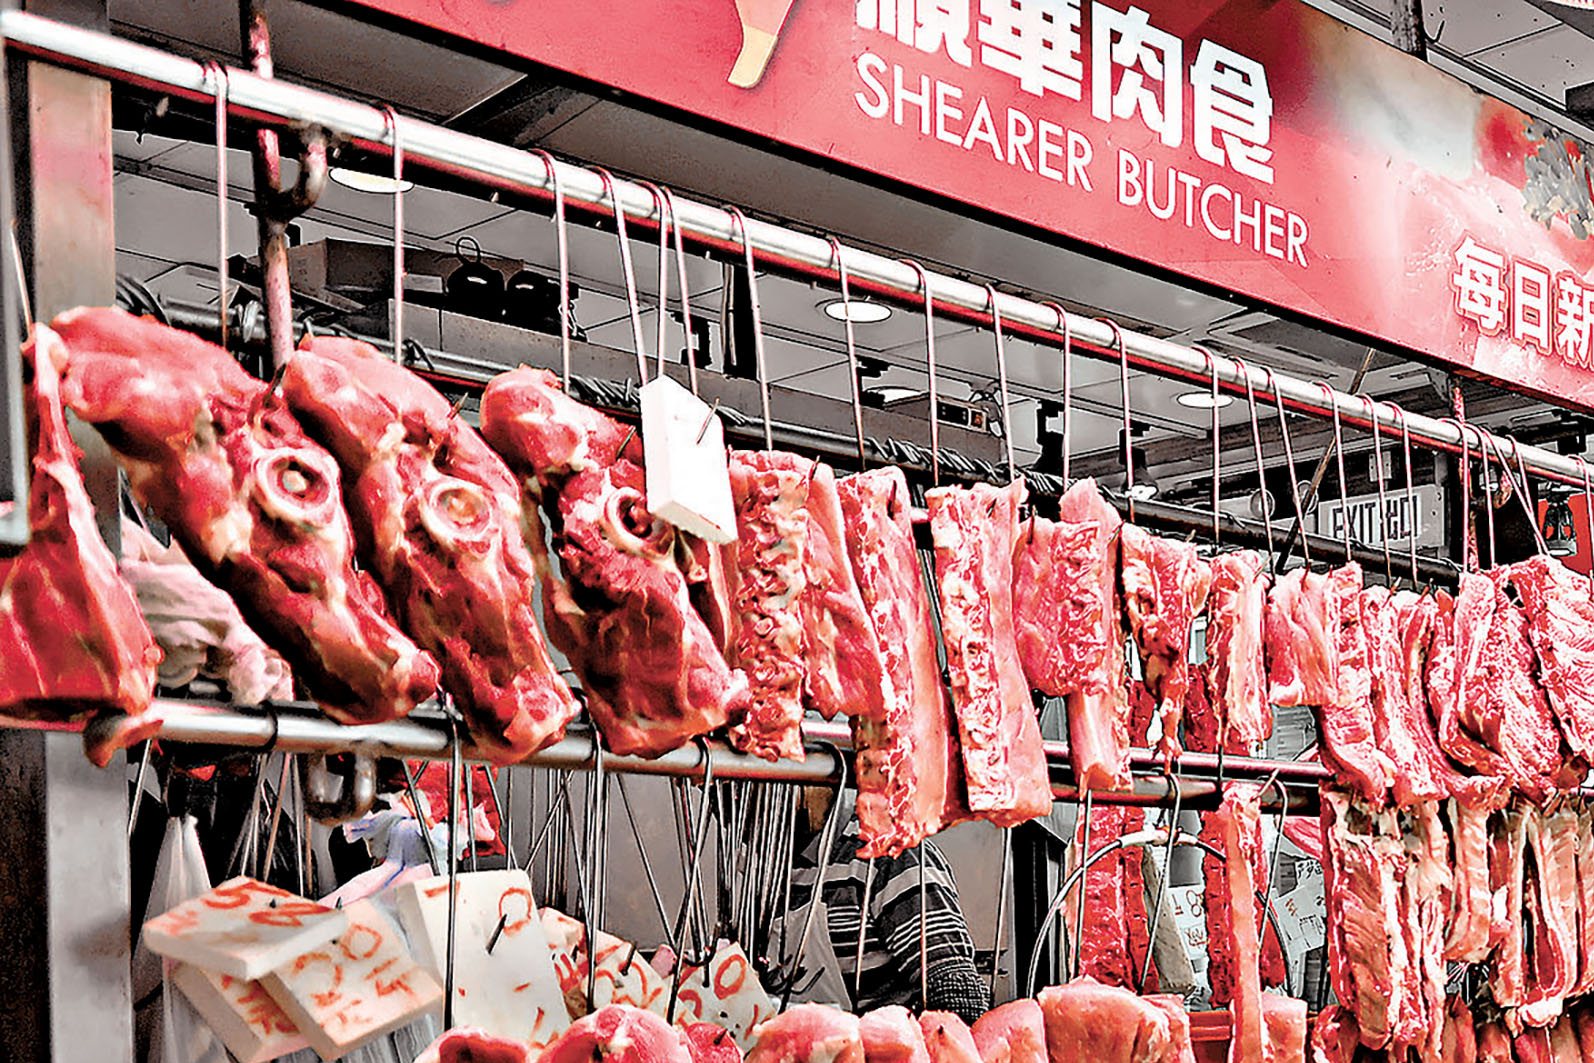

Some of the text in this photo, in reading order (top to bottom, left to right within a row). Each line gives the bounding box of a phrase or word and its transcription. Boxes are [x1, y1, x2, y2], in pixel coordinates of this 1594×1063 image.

[854, 52, 1309, 269] SHEARER BUTCHER
[1332, 502, 1376, 544] EXIT
